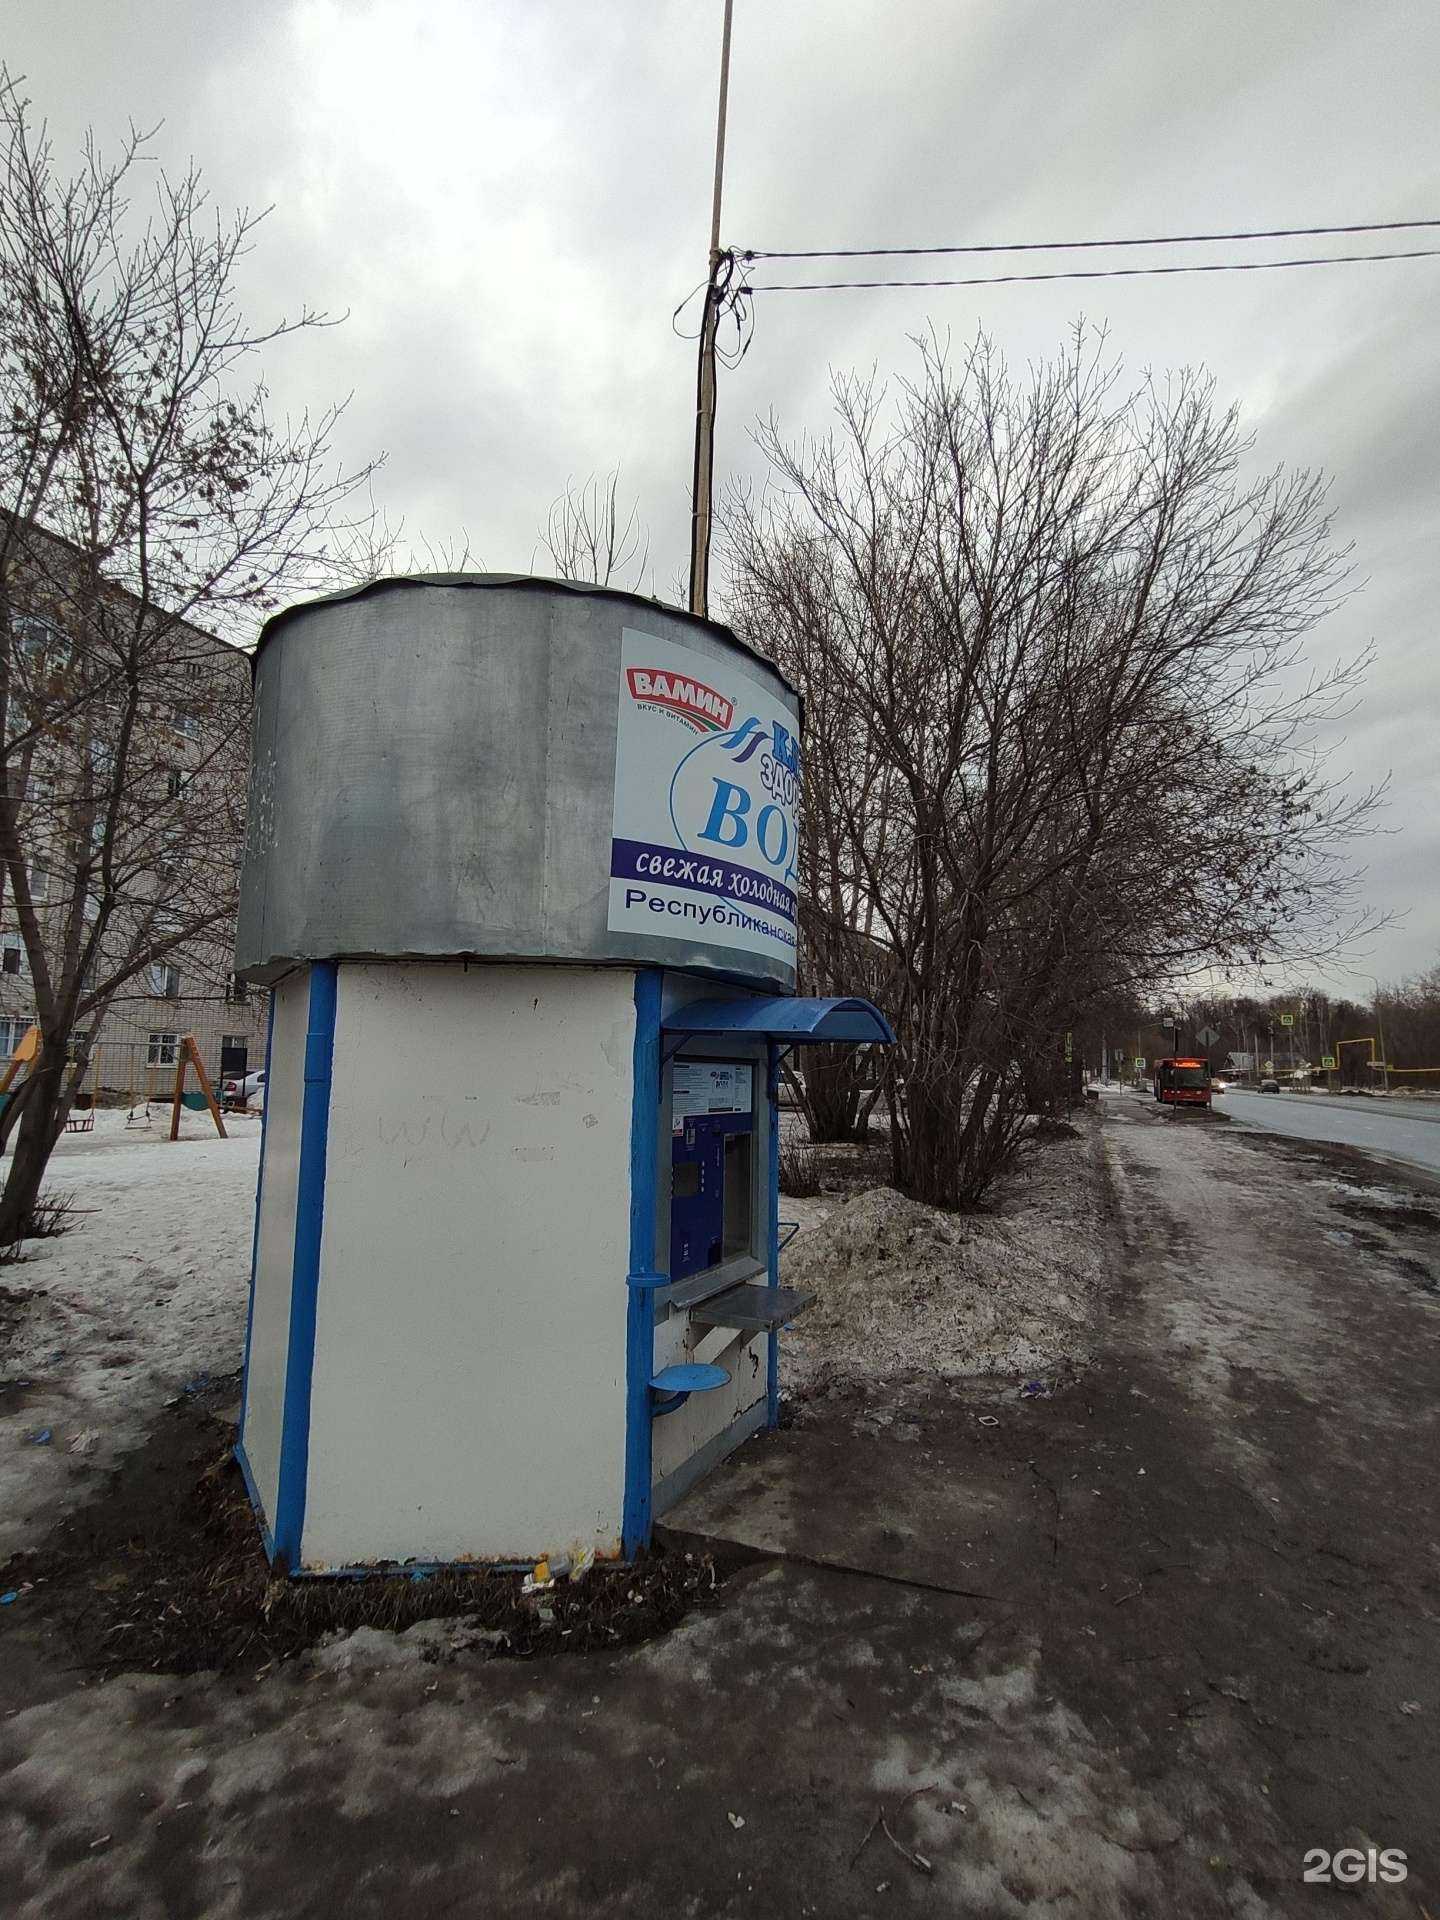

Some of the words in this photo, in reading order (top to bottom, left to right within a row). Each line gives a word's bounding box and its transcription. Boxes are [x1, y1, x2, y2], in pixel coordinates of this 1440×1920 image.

[633, 671, 729, 723] ВАМИН
[637, 703, 657, 713] ВКУС
[635, 853, 724, 886] свежая
[727, 871, 791, 914] холодная
